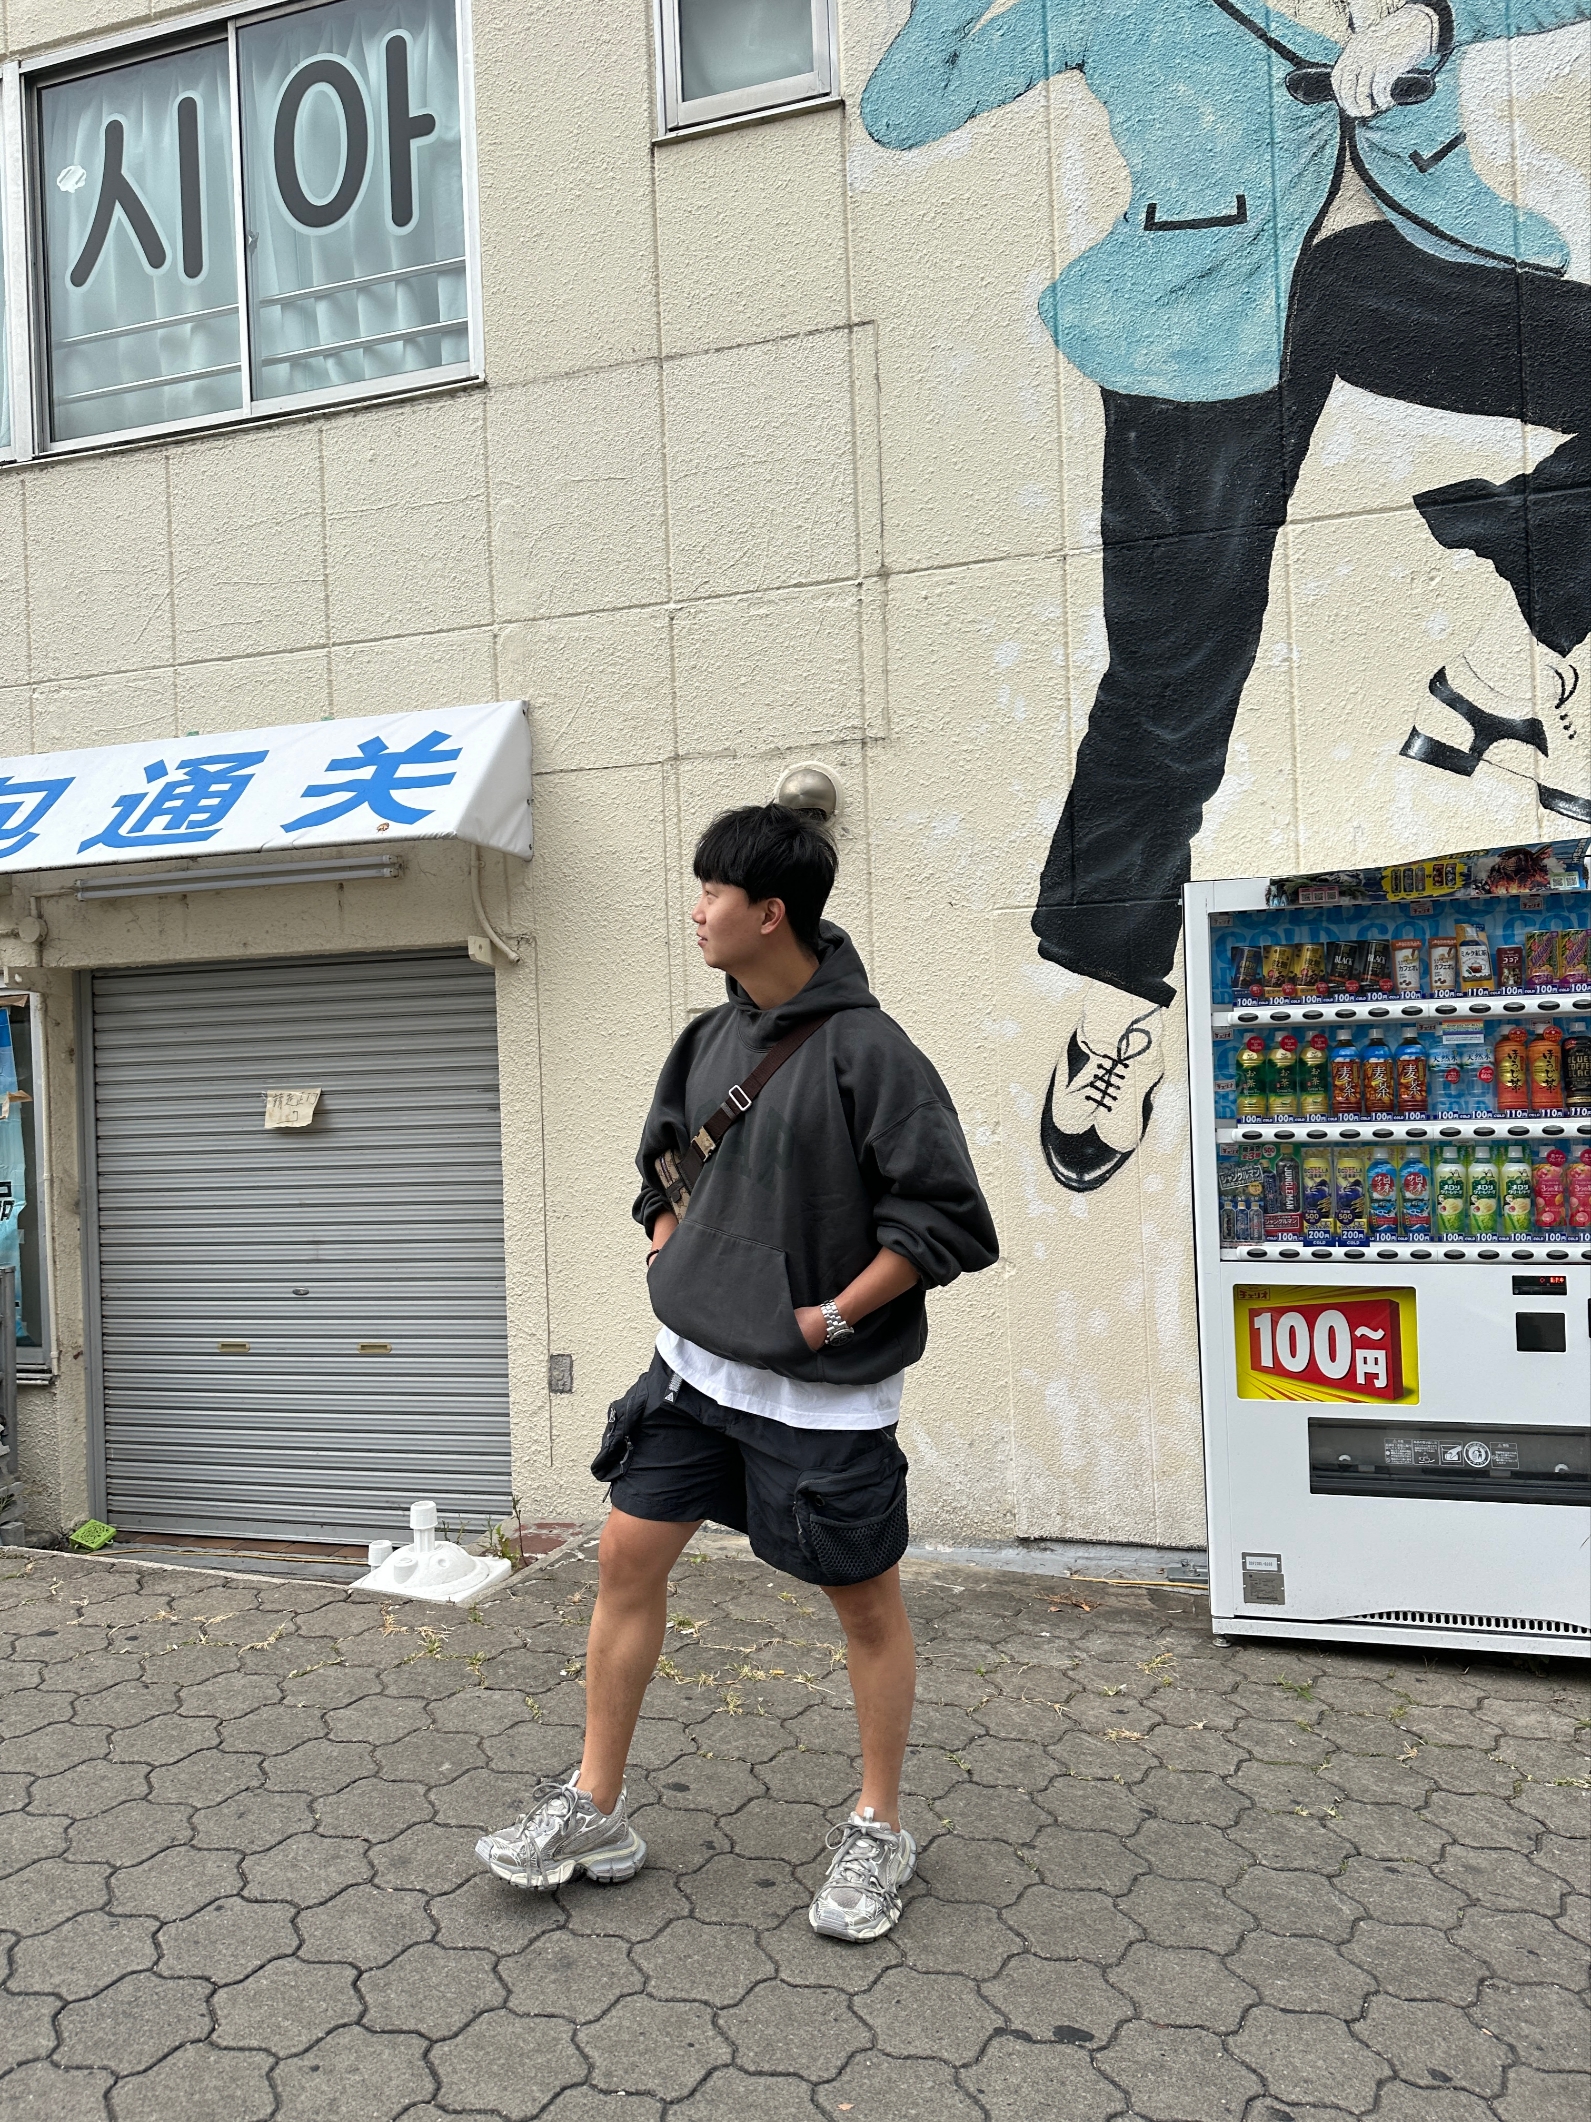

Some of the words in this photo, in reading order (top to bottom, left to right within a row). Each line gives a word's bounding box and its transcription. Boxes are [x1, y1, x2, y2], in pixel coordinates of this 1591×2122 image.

[68, 32, 438, 290] 시아
[1334, 955, 1353, 966] BLACK
[1503, 956, 1519, 964] ココア
[1280, 1069, 1290, 1088] お茶
[1311, 1068, 1321, 1086] お茶
[1338, 1066, 1355, 1097] 麦茶
[1372, 1066, 1390, 1098] 麦茶
[1403, 1064, 1421, 1095] 麦茶
[1504, 1049, 1523, 1093] ほうじ茶
[1539, 1049, 1557, 1093] ほうじ茶
[1284, 1168, 1294, 1210] JUNGLEMAN
[1308, 1231, 1329, 1239] 200円
[1342, 1231, 1363, 1239] 200円
[1239, 1290, 1268, 1299] チェリオ
